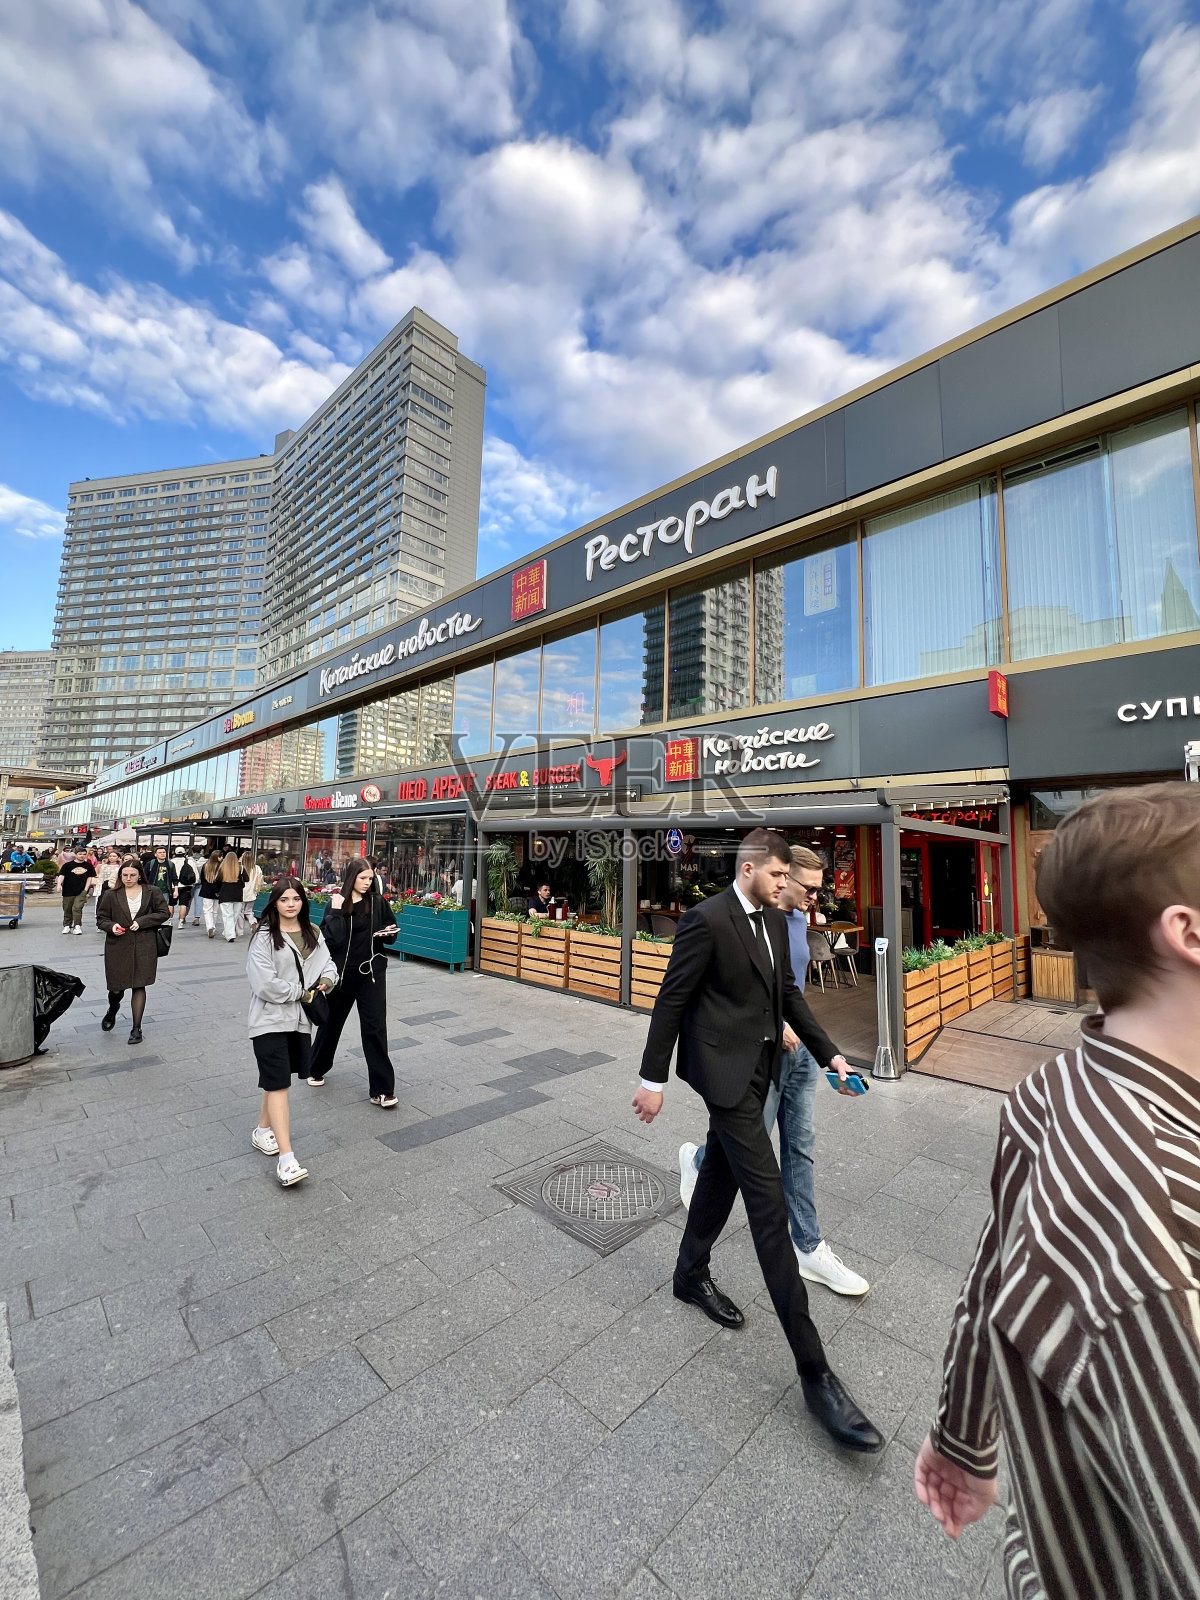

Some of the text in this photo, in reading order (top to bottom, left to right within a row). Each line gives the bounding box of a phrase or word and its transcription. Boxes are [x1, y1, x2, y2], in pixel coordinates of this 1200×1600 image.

[584, 465, 778, 582] Ресторан
[516, 566, 541, 593] 中華
[515, 586, 540, 614] 新闻
[319, 612, 483, 697] Китайские новости
[1117, 696, 1200, 722] СУП
[670, 741, 696, 760] 中華
[703, 722, 835, 758] Китайские
[669, 760, 696, 777] 新闻
[715, 747, 821, 776] новости
[397, 764, 581, 801] ШЕФ АРБАТ STEAK & BURGER
[680, 864, 699, 872] МАЯ
